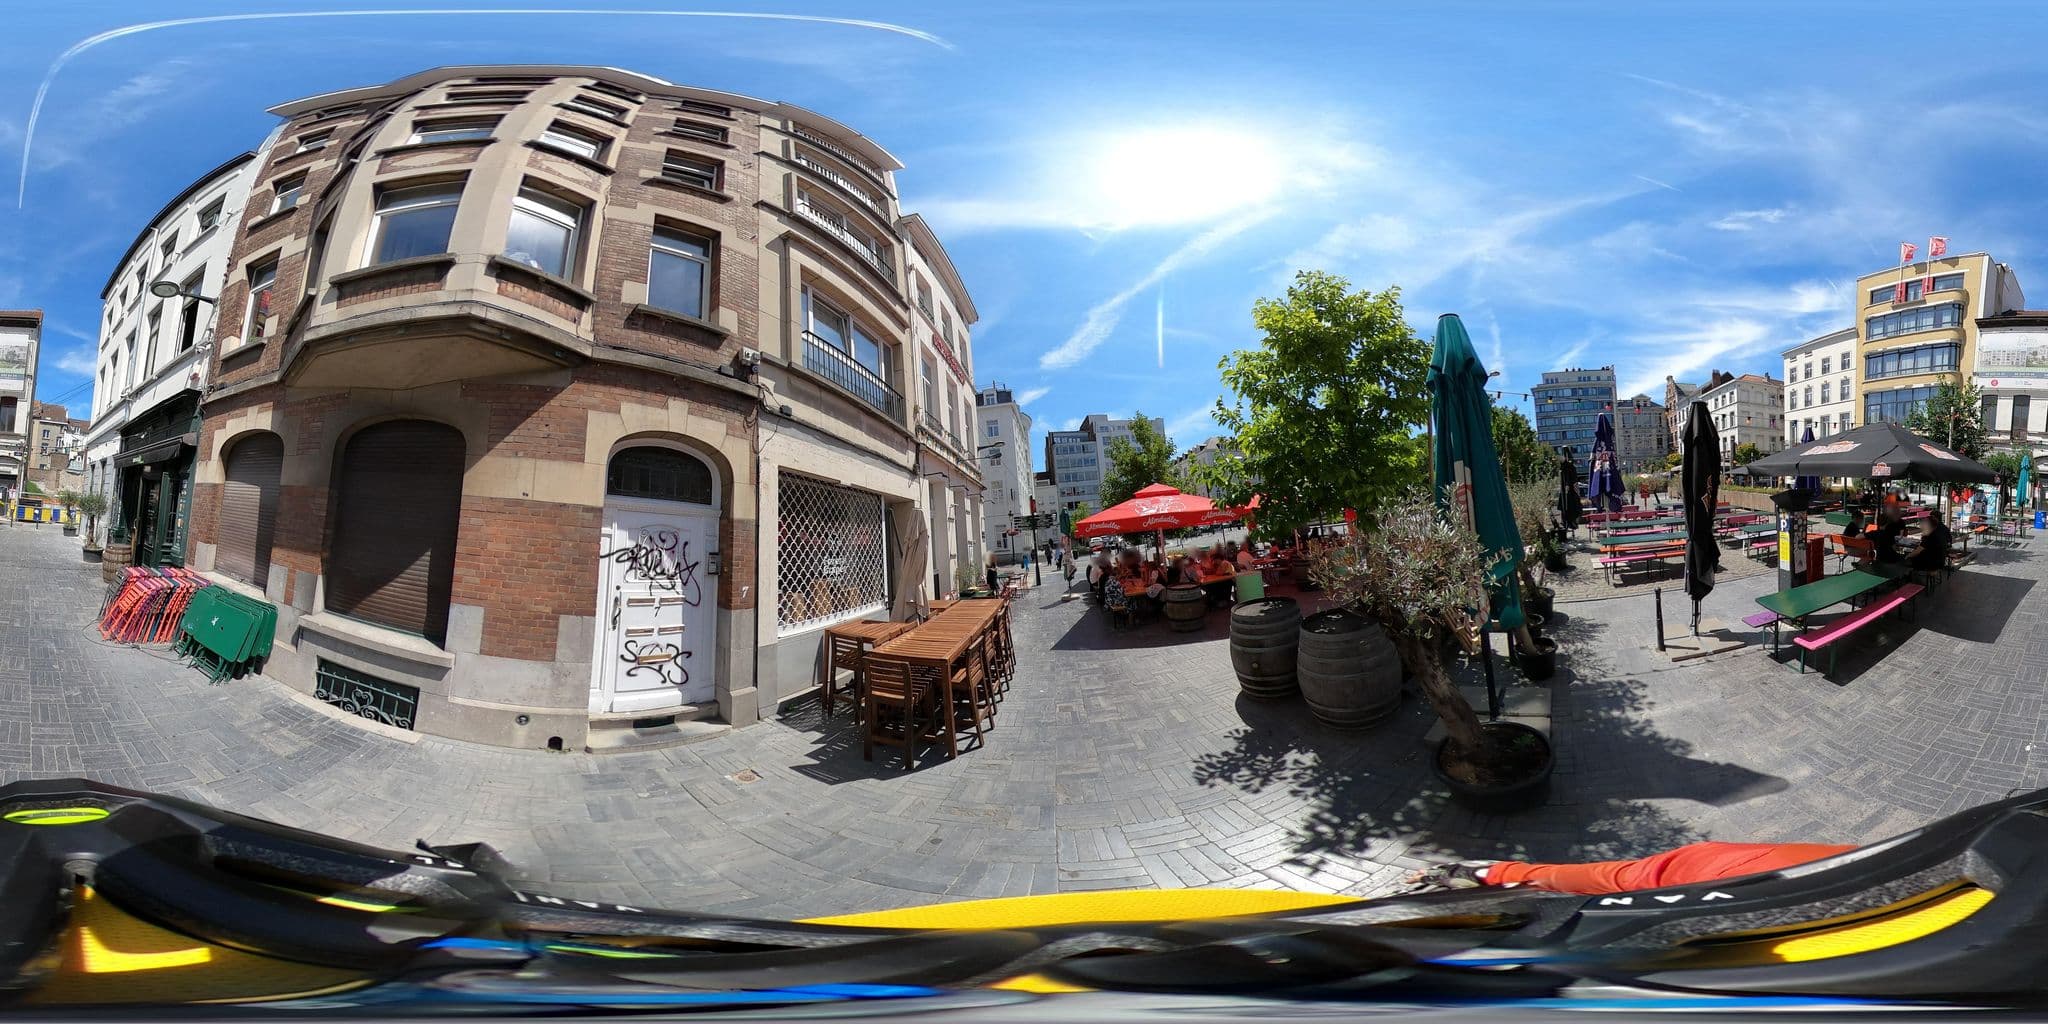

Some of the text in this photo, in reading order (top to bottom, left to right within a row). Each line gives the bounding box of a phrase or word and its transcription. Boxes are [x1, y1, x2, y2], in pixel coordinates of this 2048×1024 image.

[1143, 515, 1180, 528] Almdudler
[1085, 522, 1121, 533] Almdudler
[742, 586, 749, 598] 7
[655, 606, 661, 617] 7
